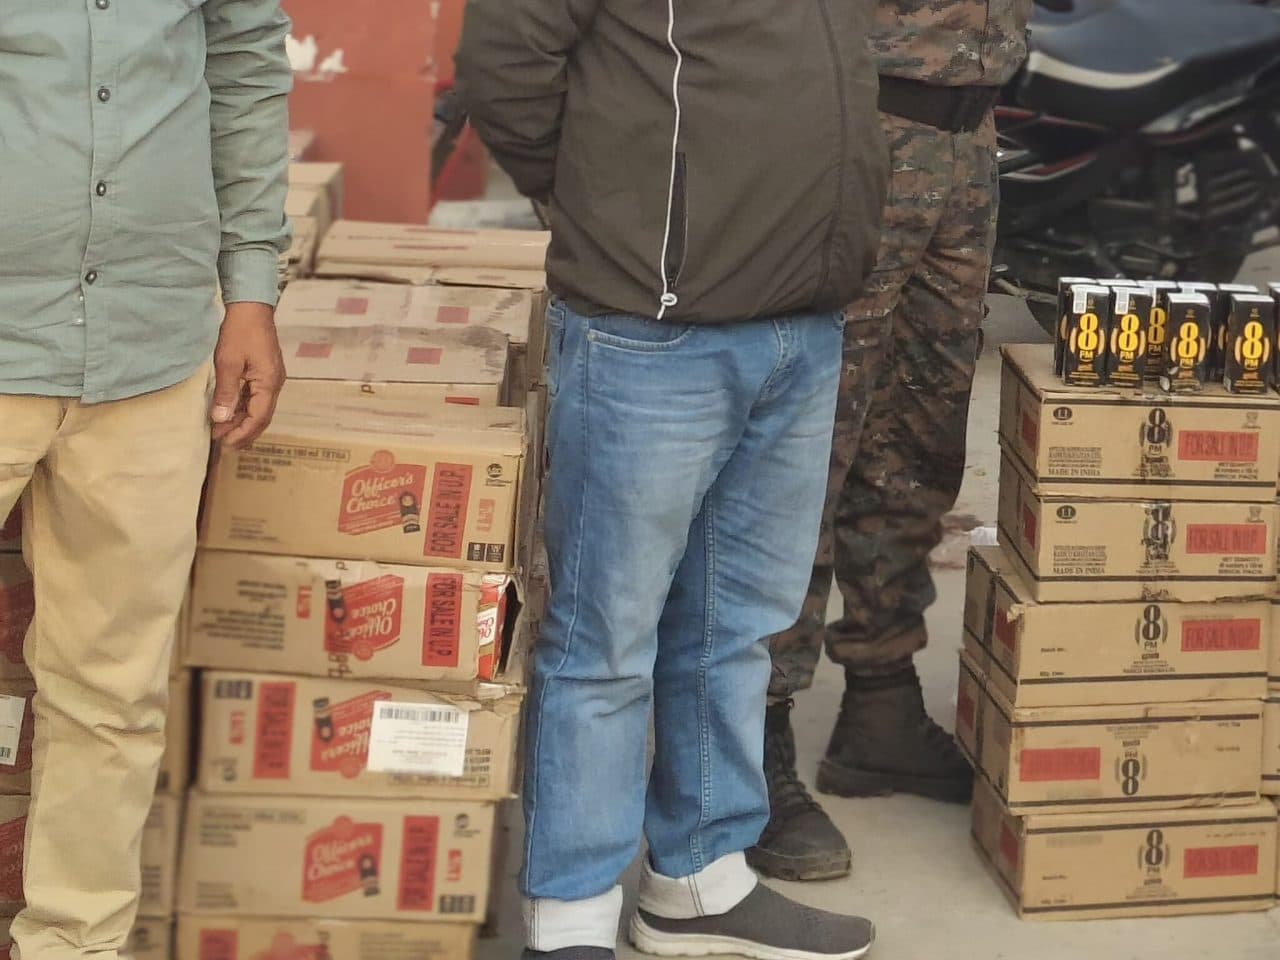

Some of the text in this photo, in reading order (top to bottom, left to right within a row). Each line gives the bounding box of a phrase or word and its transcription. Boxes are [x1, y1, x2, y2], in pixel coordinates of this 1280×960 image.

[1077, 312, 1098, 351] 8
[1118, 314, 1139, 351] 8
[1149, 308, 1165, 344] 8
[1178, 322, 1199, 358] 8
[1242, 321, 1263, 358] 8
[1147, 408, 1166, 444] 8
[352, 473, 413, 498] Officer's
[347, 495, 396, 513] Choice
[432, 502, 461, 530] SALE
[430, 531, 457, 554] FOR
[432, 578, 457, 598] FOR
[352, 599, 397, 617] Choice
[430, 599, 456, 626] SALE
[1142, 604, 1161, 641] 8
[430, 627, 454, 638] IN
[1144, 641, 1158, 650] PM
[1122, 758, 1140, 796] 8
[1145, 829, 1163, 866] 8
